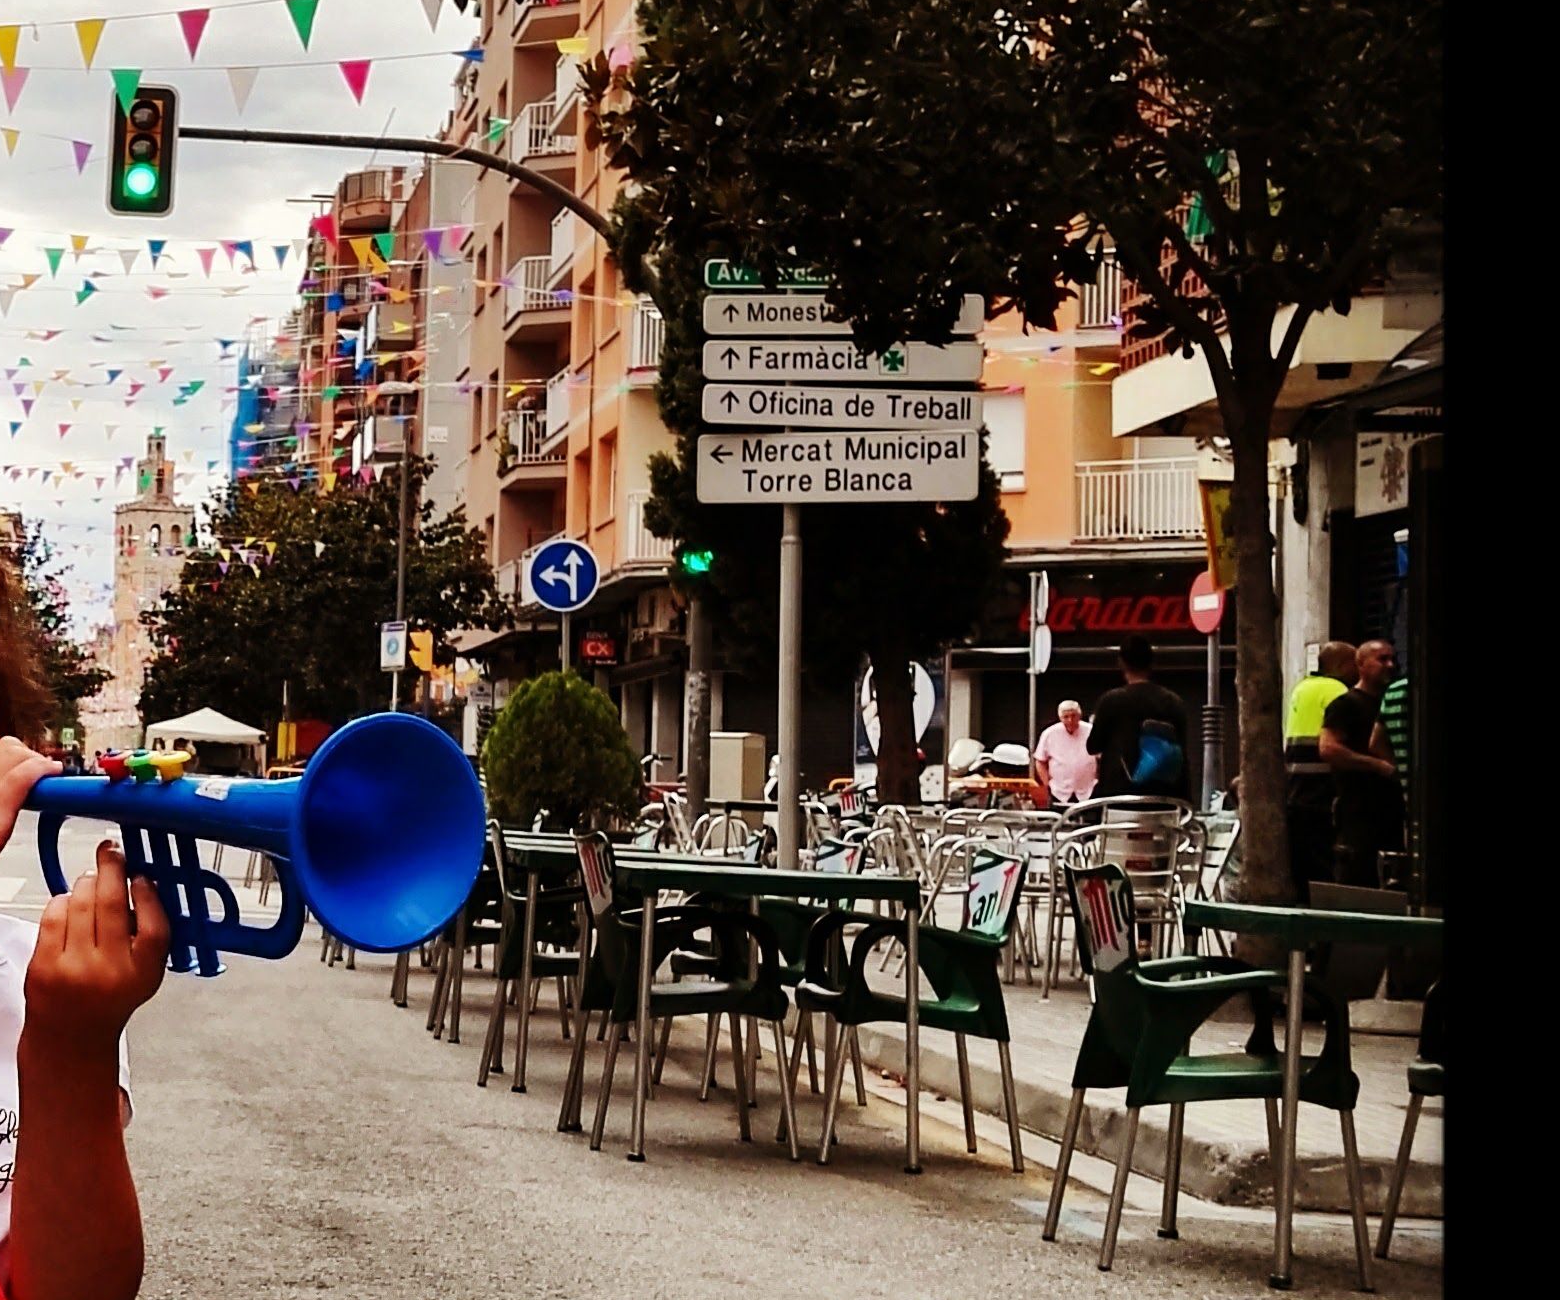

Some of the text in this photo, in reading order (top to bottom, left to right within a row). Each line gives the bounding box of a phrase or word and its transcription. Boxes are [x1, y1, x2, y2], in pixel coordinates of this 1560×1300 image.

[717, 263, 749, 281] Av.
[748, 346, 868, 371] Farmàcia
[748, 390, 972, 421] Oficina de Treball
[742, 435, 966, 464] Mercat Municipal
[742, 467, 912, 493] Torre Blanca
[586, 641, 609, 656] CX
